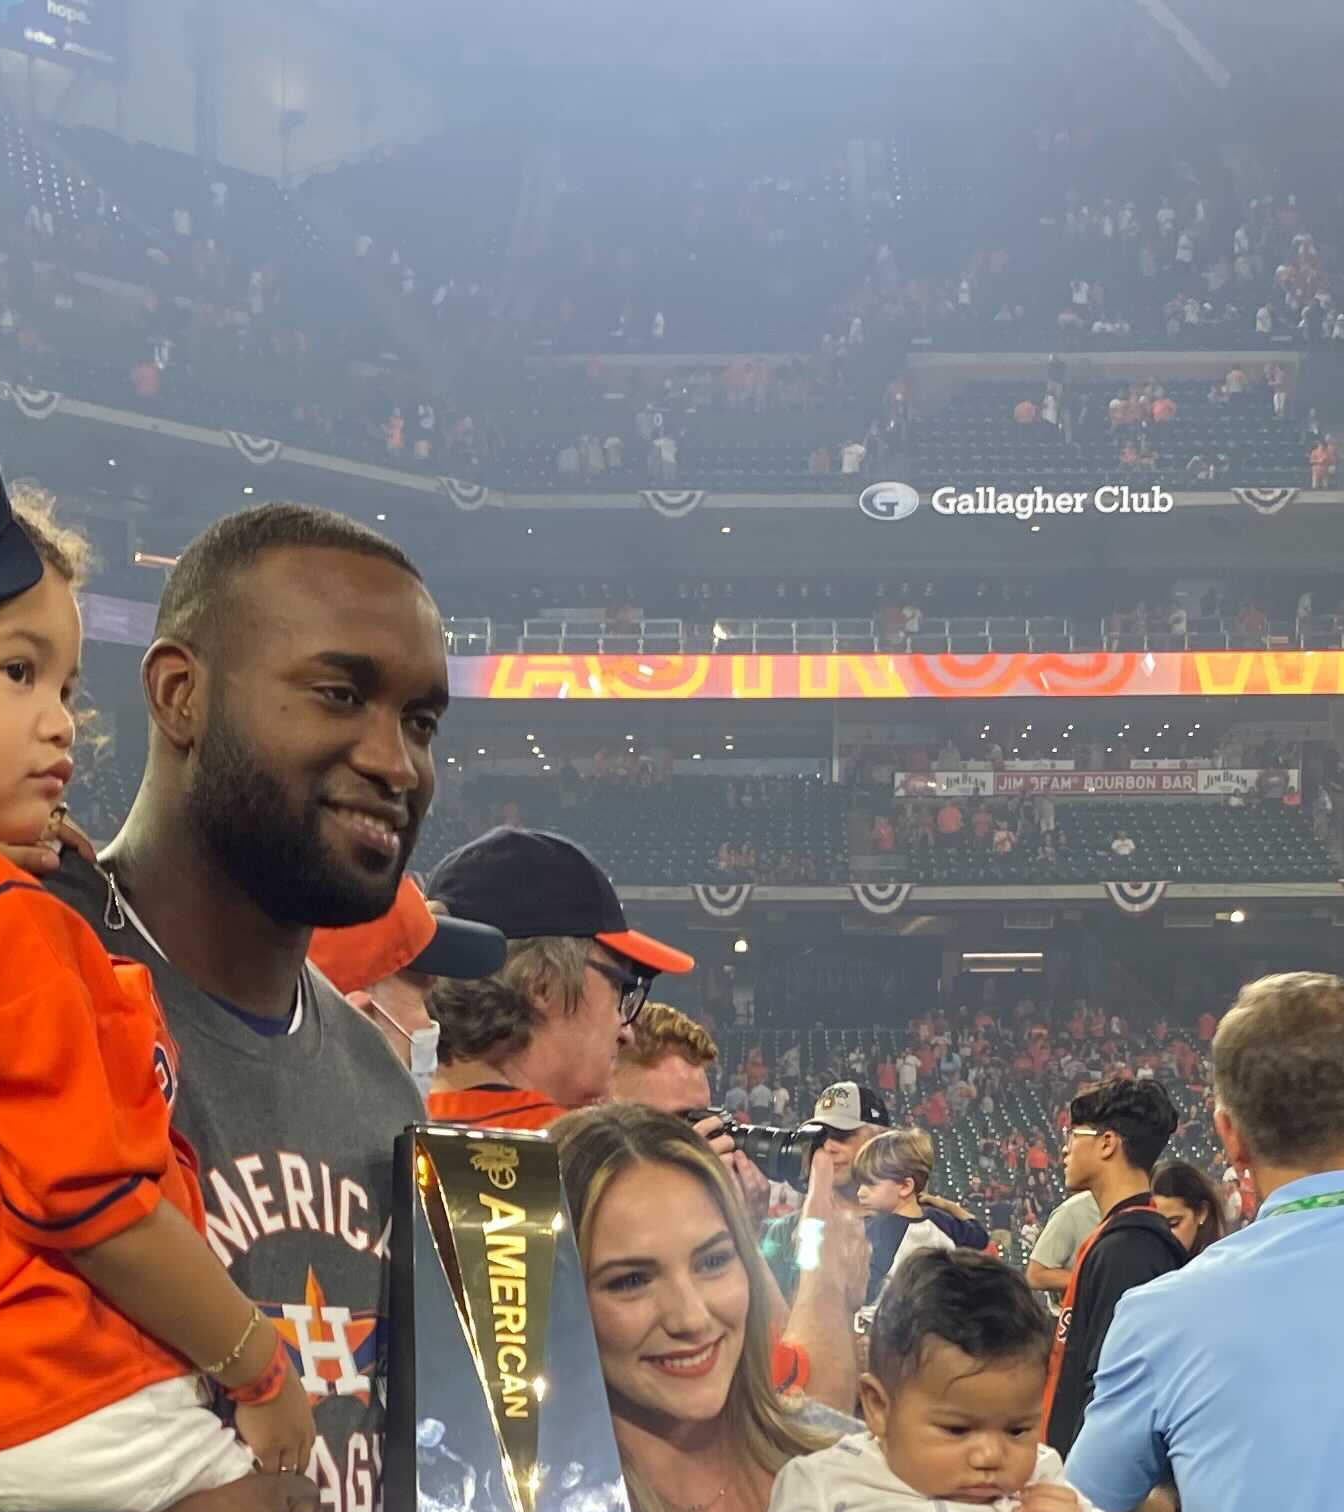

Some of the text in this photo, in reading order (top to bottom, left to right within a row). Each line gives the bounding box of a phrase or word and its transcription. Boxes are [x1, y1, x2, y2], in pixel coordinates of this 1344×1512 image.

[931, 486, 1174, 519] Gallagher Club
[1083, 775, 1156, 790] BOURBON
[1162, 775, 1193, 789] BAR
[479, 1192, 529, 1418] AMERICAN
